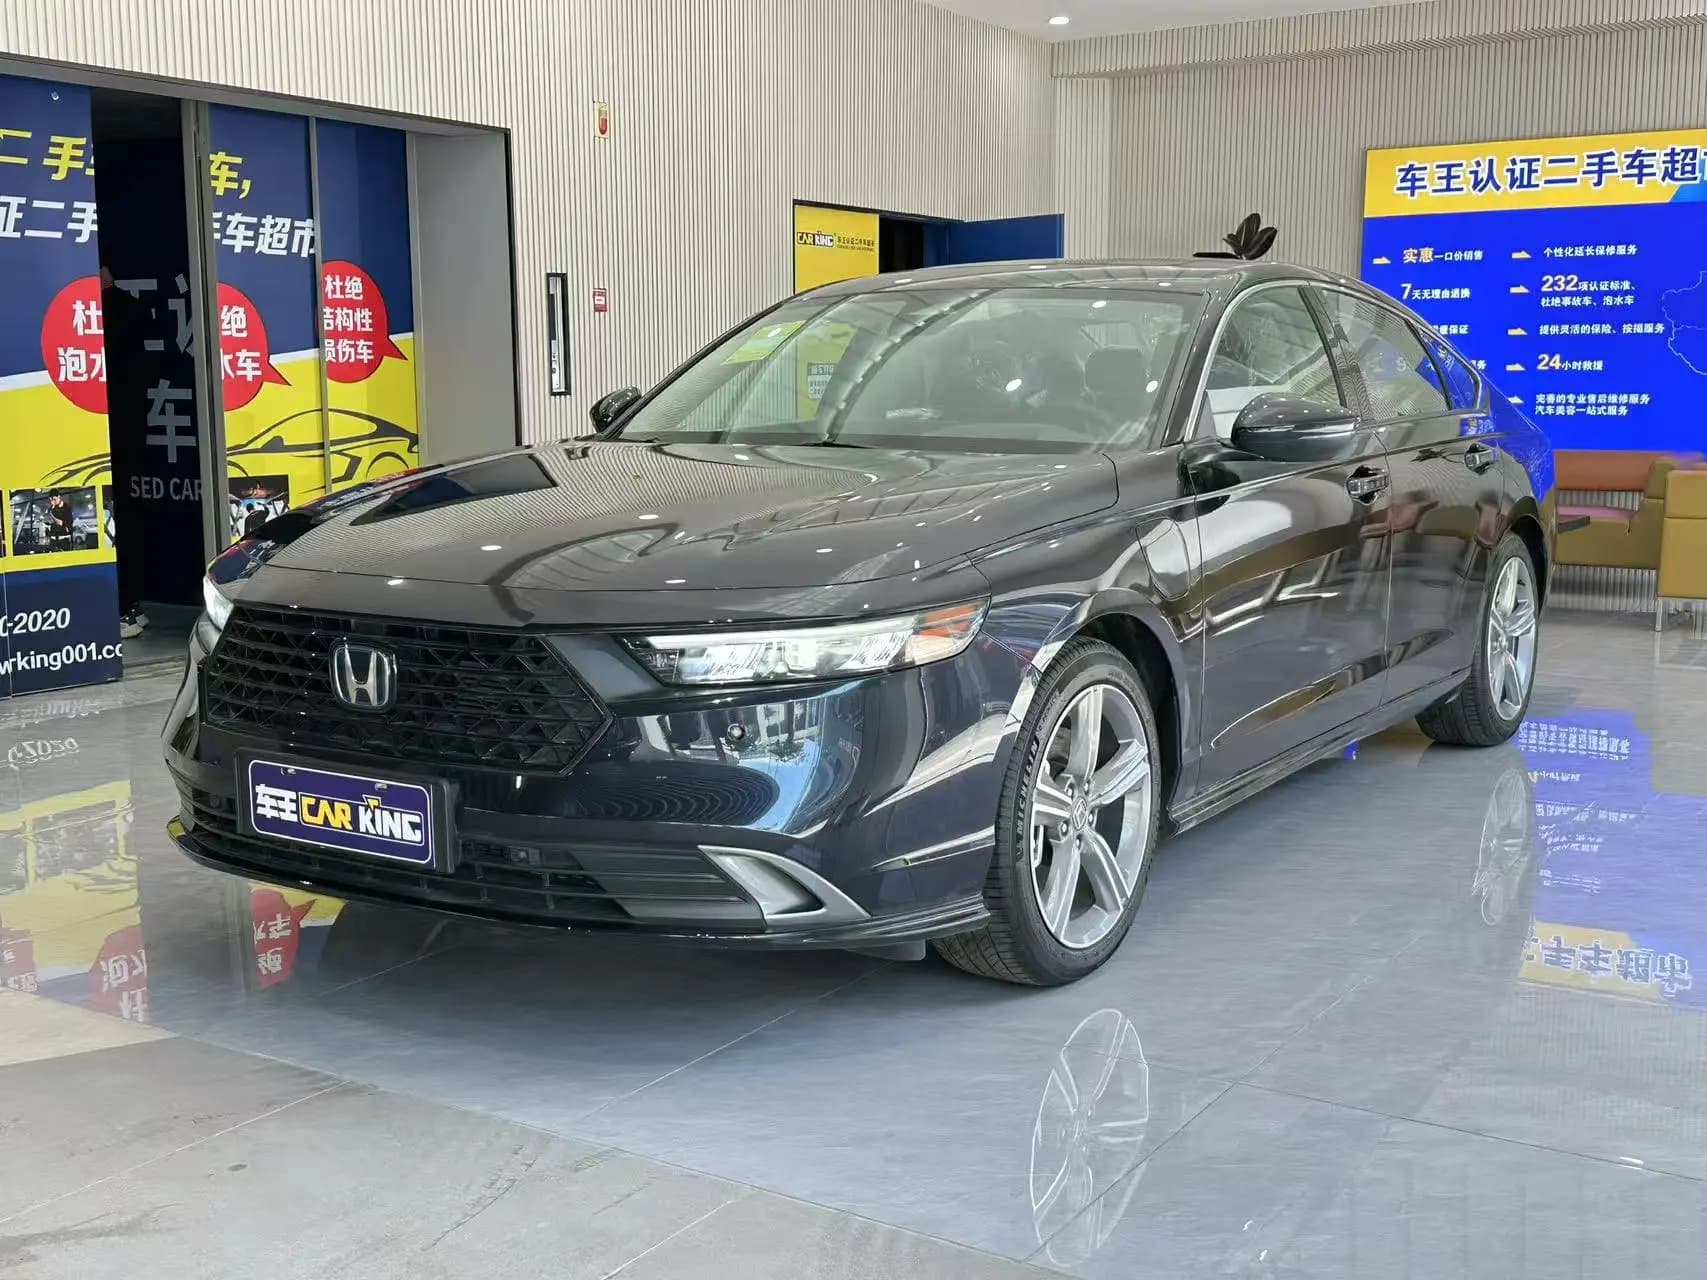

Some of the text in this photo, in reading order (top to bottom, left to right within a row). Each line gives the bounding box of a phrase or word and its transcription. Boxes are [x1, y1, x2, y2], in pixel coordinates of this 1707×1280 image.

[1395, 145, 1707, 197] 车王认证二手车超
[1543, 245, 1638, 258] 个性化延长保修服务
[325, 274, 364, 301] 杜绝
[221, 305, 248, 338] 绝
[130, 475, 165, 500] SED
[1015, 738, 1039, 837] MICHELIN
[301, 795, 422, 842] CAR KING
